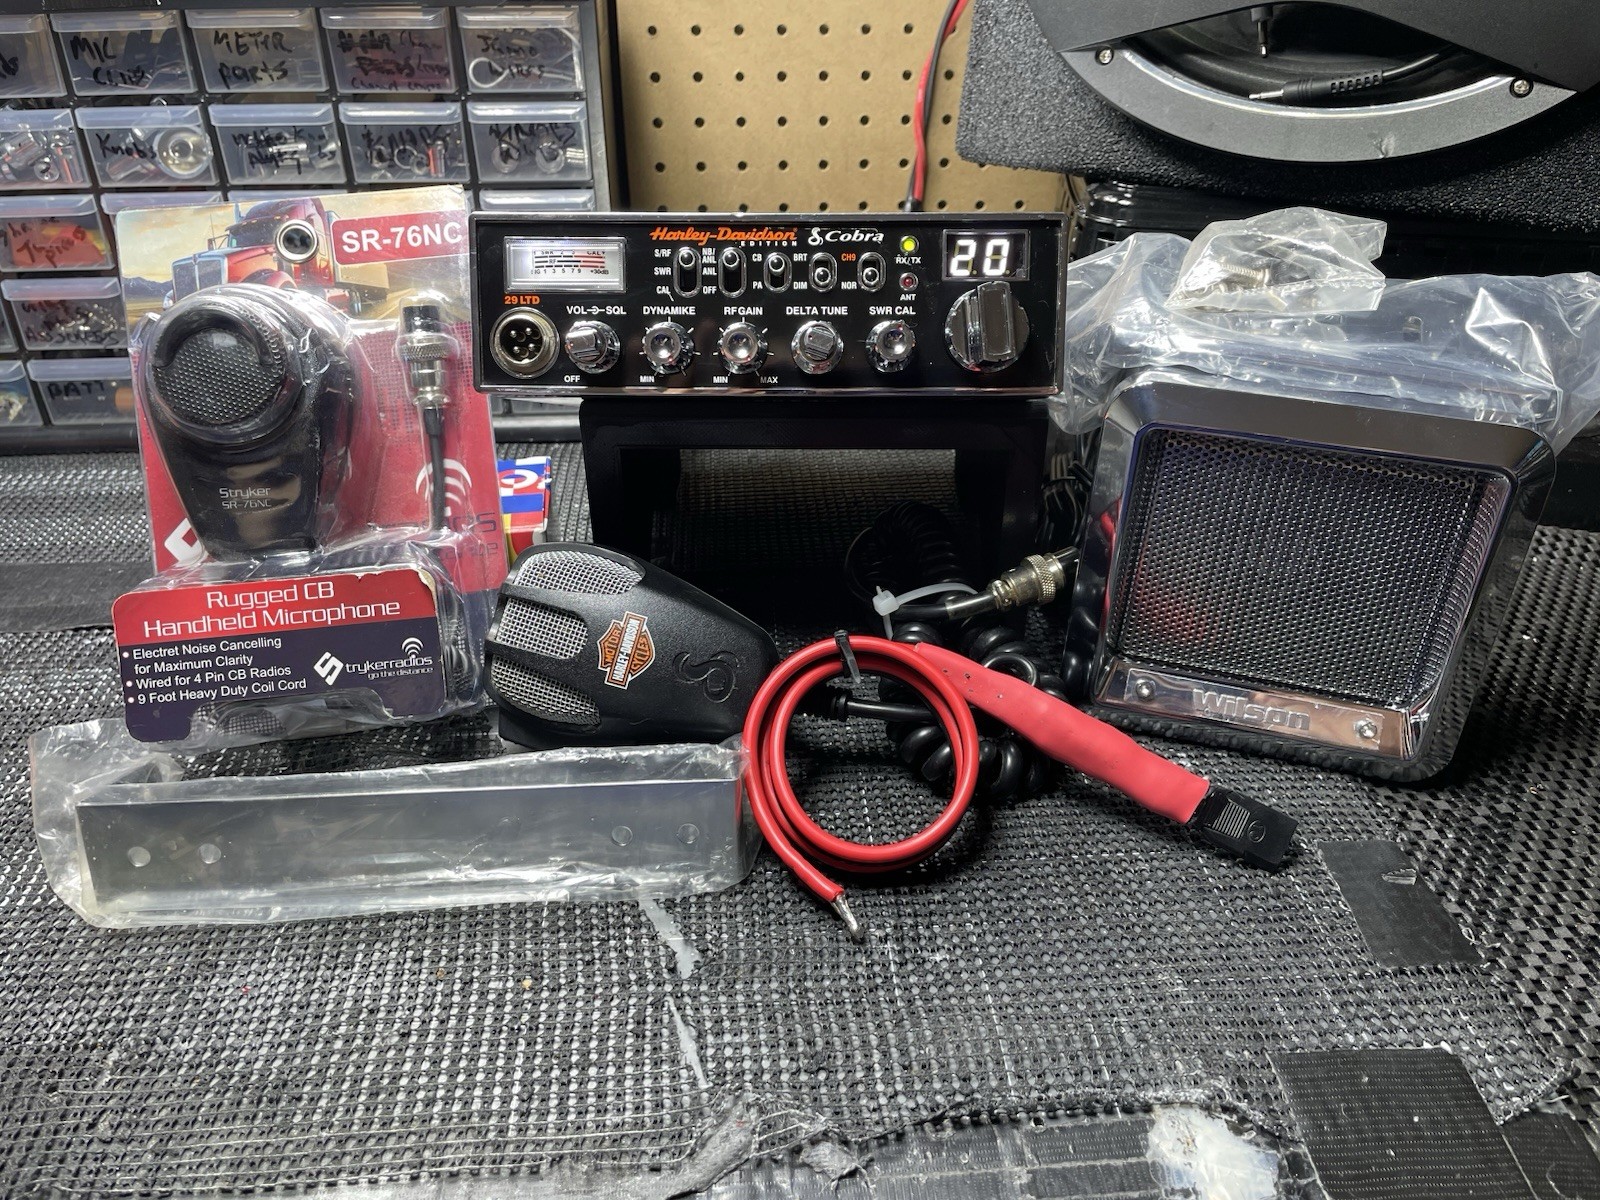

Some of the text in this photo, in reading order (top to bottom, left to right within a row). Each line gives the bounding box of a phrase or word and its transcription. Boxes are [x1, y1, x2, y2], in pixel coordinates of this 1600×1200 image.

[341, 220, 463, 255] SR-76NC
[650, 227, 797, 246] Harley-Davidson
[824, 230, 885, 243] Cobra
[654, 248, 672, 258] S/RF
[752, 253, 763, 262] CB
[793, 253, 808, 262] BRT
[841, 253, 856, 262] CH9
[949, 239, 1010, 277] 20
[702, 255, 717, 263] ANL
[654, 266, 672, 276] SWR
[702, 267, 717, 276] ANL
[656, 285, 671, 295] CAL
[702, 285, 717, 295] OFF
[752, 281, 763, 290] PA
[793, 281, 808, 290] DIM
[841, 281, 857, 290] NOR
[504, 295, 540, 305] 29 LTD
[900, 293, 916, 301] ANT
[643, 306, 696, 316] DYNAMIKE
[786, 306, 848, 315] DELTA TUNE
[869, 306, 916, 316] SWR CAL
[564, 375, 580, 383] OFF
[640, 375, 655, 384] MIN
[713, 376, 728, 384] MIN
[760, 376, 778, 384] MAX
[219, 487, 271, 499] Stryker
[206, 581, 335, 610] Rugged CB
[143, 601, 400, 638] Handheld Microphone
[132, 637, 282, 660] Electret Noise Cancelling
[134, 654, 253, 675] for Maximum Clarity
[136, 665, 292, 690] Wired for 4 Pin CB Radios
[137, 678, 307, 705] 9 Foot Heavy Duty Coil Cord
[1192, 688, 1310, 731] Wilson
